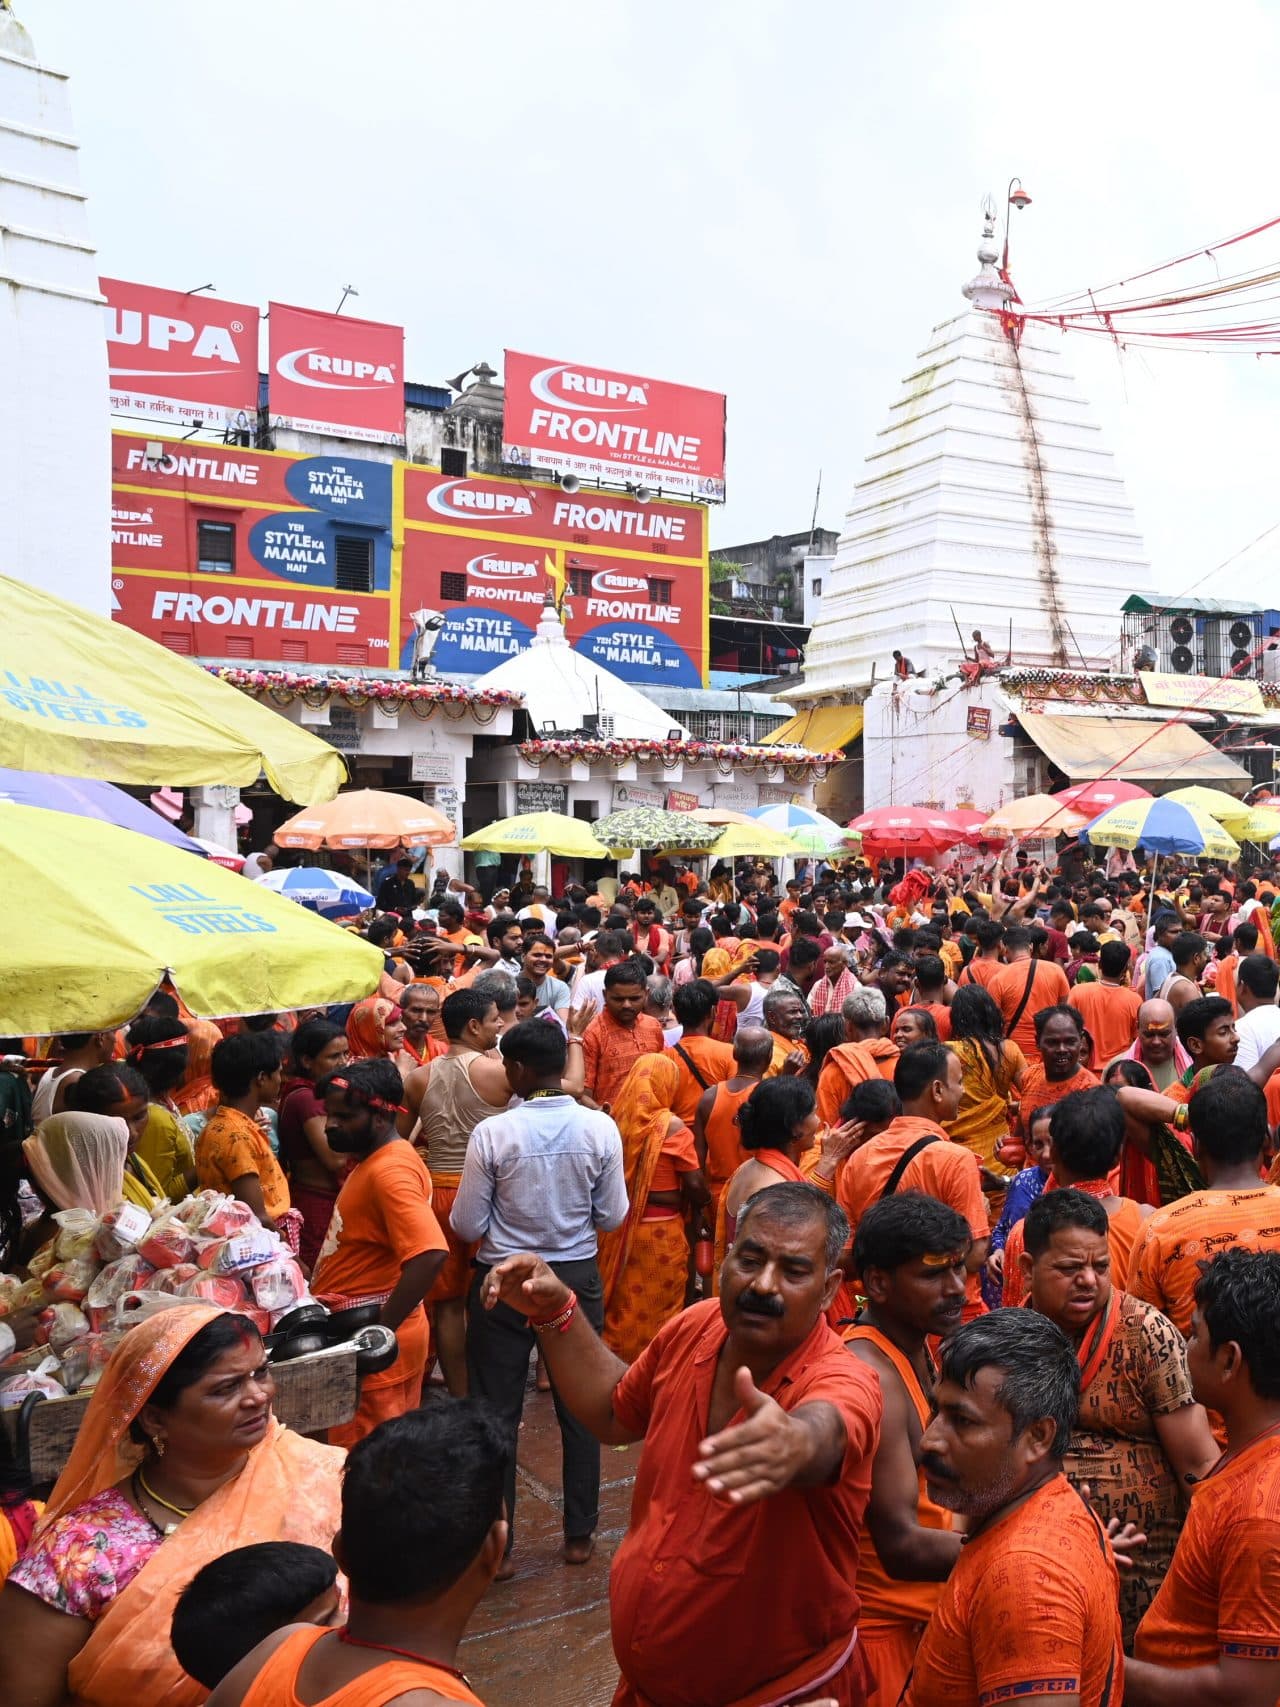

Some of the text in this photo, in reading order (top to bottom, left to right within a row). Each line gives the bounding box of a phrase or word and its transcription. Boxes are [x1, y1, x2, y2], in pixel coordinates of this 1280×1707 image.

[308, 353, 395, 384] RUPA
[561, 371, 648, 405] RUPA
[134, 400, 145, 409] का
[150, 400, 174, 413] हार्दिक
[179, 406, 204, 418] स्वागत
[529, 408, 701, 462] FRONTLINE
[622, 453, 646, 463] STYLE
[658, 459, 687, 470] MAMLA
[308, 470, 353, 487] STYLE
[309, 483, 364, 500] MAMLA
[452, 488, 533, 515] RUPA
[553, 501, 686, 541] FRONTLINE
[264, 531, 325, 550] STYLE KA
[264, 545, 326, 565] MAMLA
[482, 558, 538, 577] RUPA
[604, 574, 649, 591] RUPA
[466, 584, 545, 604] FRONTLINE
[151, 591, 360, 633] FRONTLINE
[586, 597, 681, 624] FRONTLINE
[465, 617, 512, 637] STYLE
[441, 631, 458, 643] KA
[461, 635, 520, 655] MAMLA
[612, 632, 654, 650] STYLE
[592, 645, 606, 655] KA
[607, 647, 661, 666] MAMLA
[4, 670, 99, 700] LALL
[0, 689, 148, 729] STEELS
[129, 884, 216, 901] LALL
[164, 913, 278, 935] STEELS
